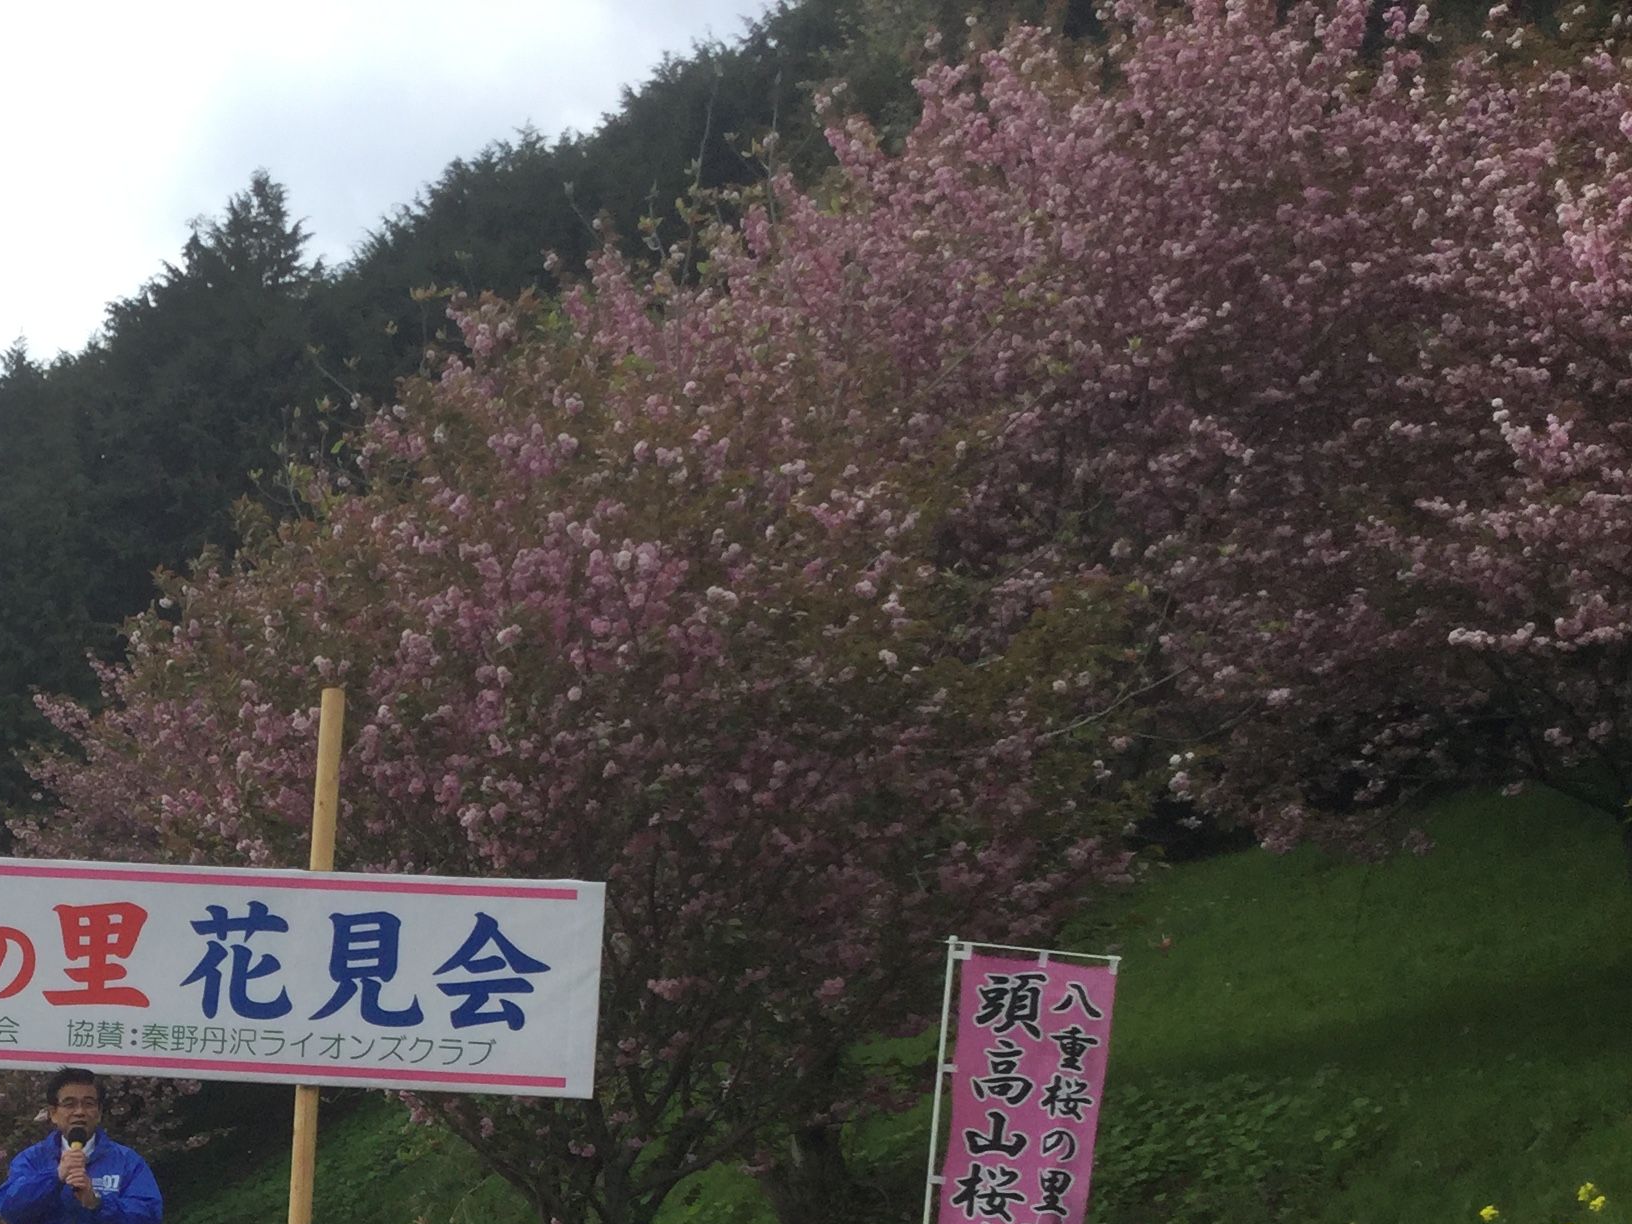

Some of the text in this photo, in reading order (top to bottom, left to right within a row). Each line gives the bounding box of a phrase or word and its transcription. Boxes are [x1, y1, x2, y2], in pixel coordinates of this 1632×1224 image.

[180, 900, 552, 1031] 花見会
[1033, 982, 1102, 1217] 八重桜の里
